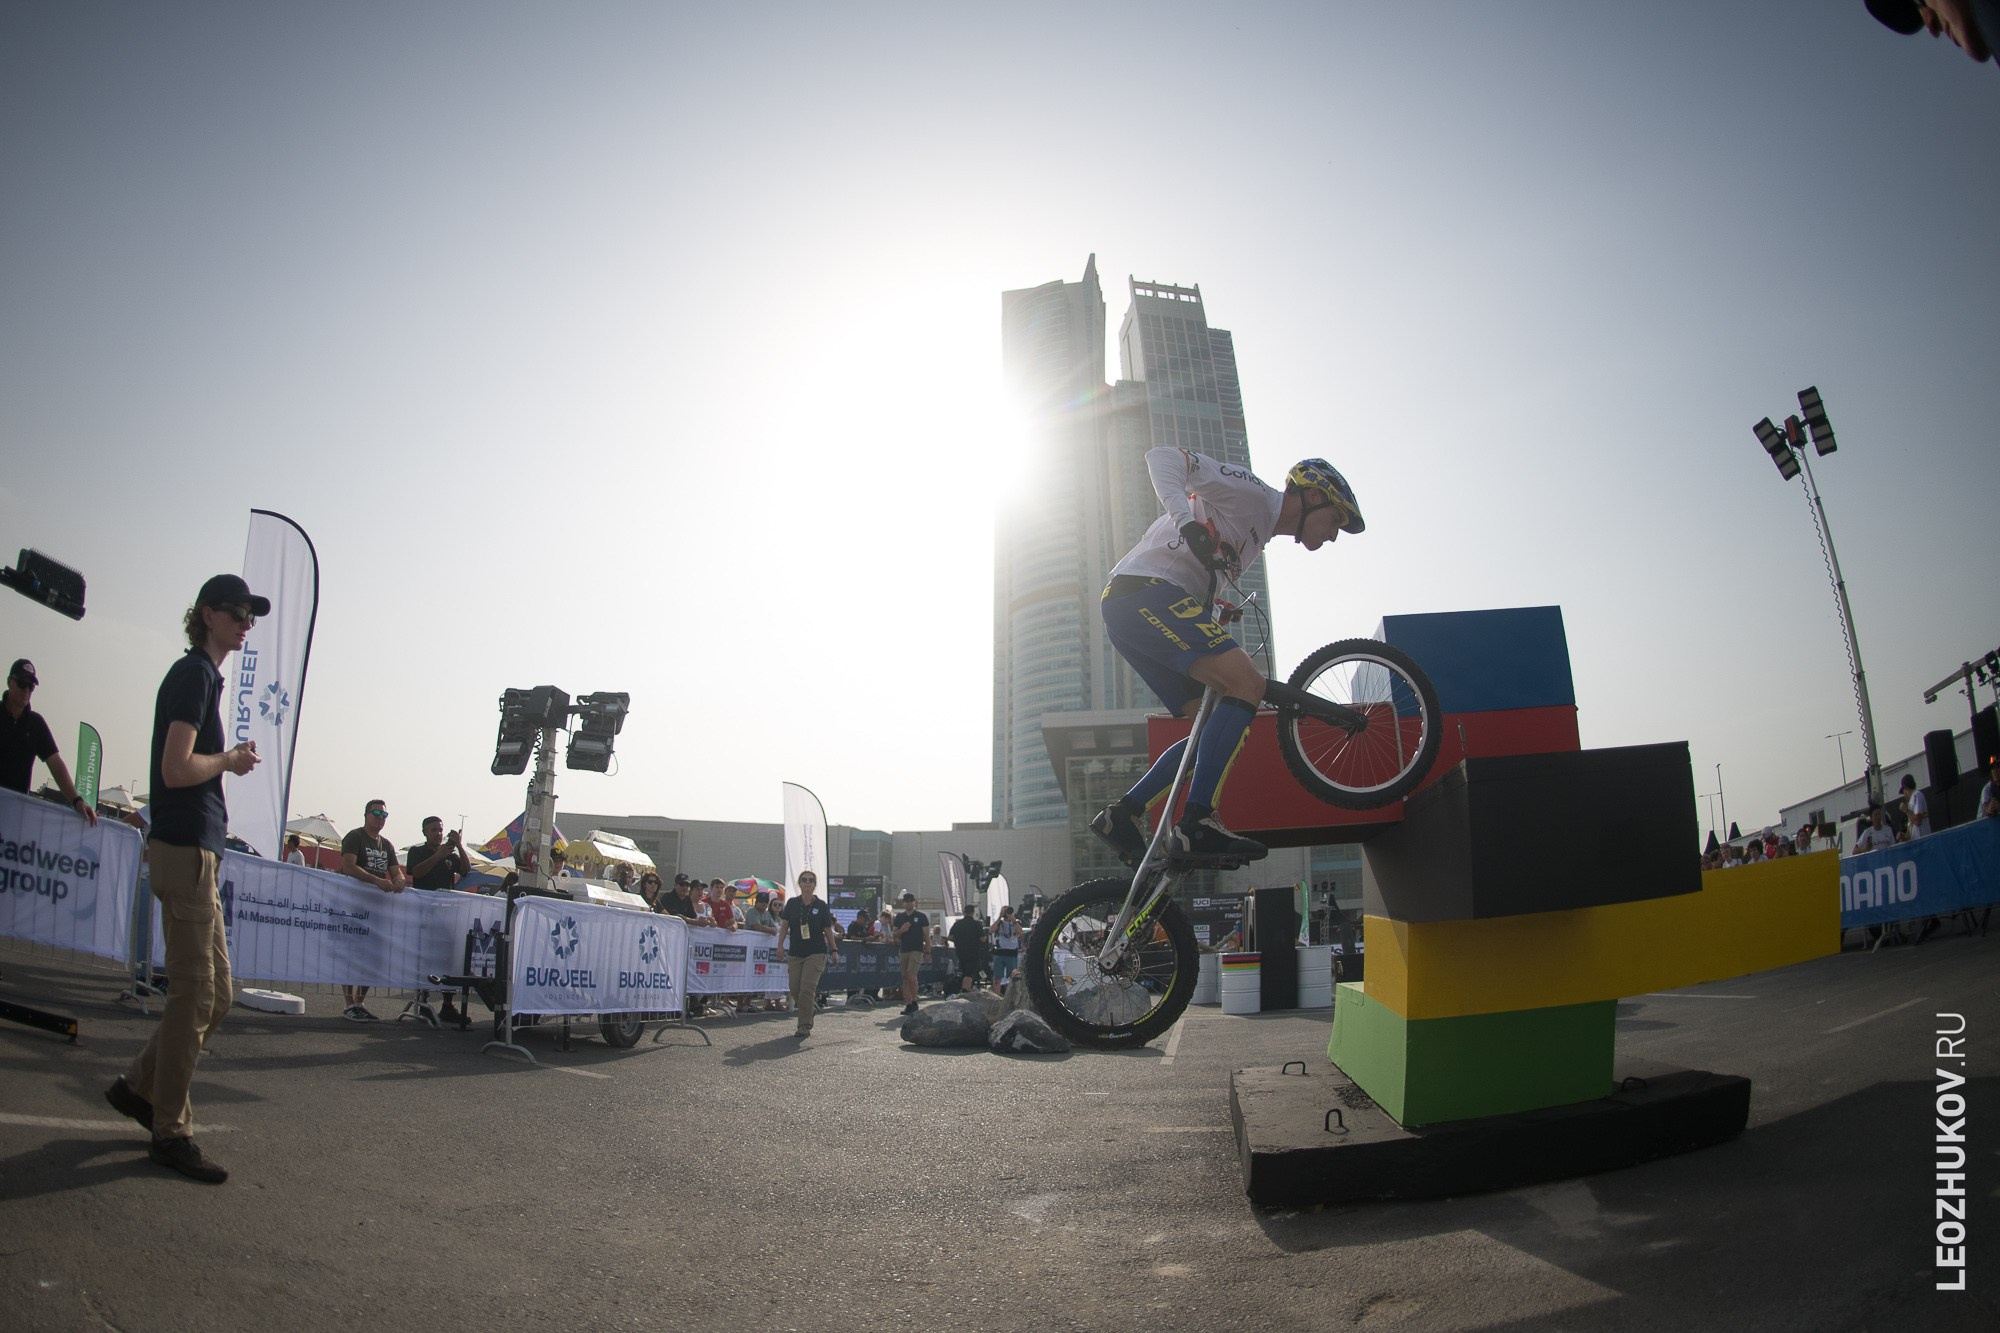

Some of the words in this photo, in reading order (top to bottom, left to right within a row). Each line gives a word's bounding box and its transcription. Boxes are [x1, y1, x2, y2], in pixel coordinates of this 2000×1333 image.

[0, 866, 68, 905] group
[237, 910, 248, 920] Al
[250, 912, 292, 926] Masaood
[294, 918, 341, 932] Equipment
[342, 923, 369, 936] Rental
[699, 946, 712, 958] UCI
[757, 949, 769, 960] UCI
[526, 967, 597, 989] BURJEEL
[619, 970, 673, 990] BURJEEL
